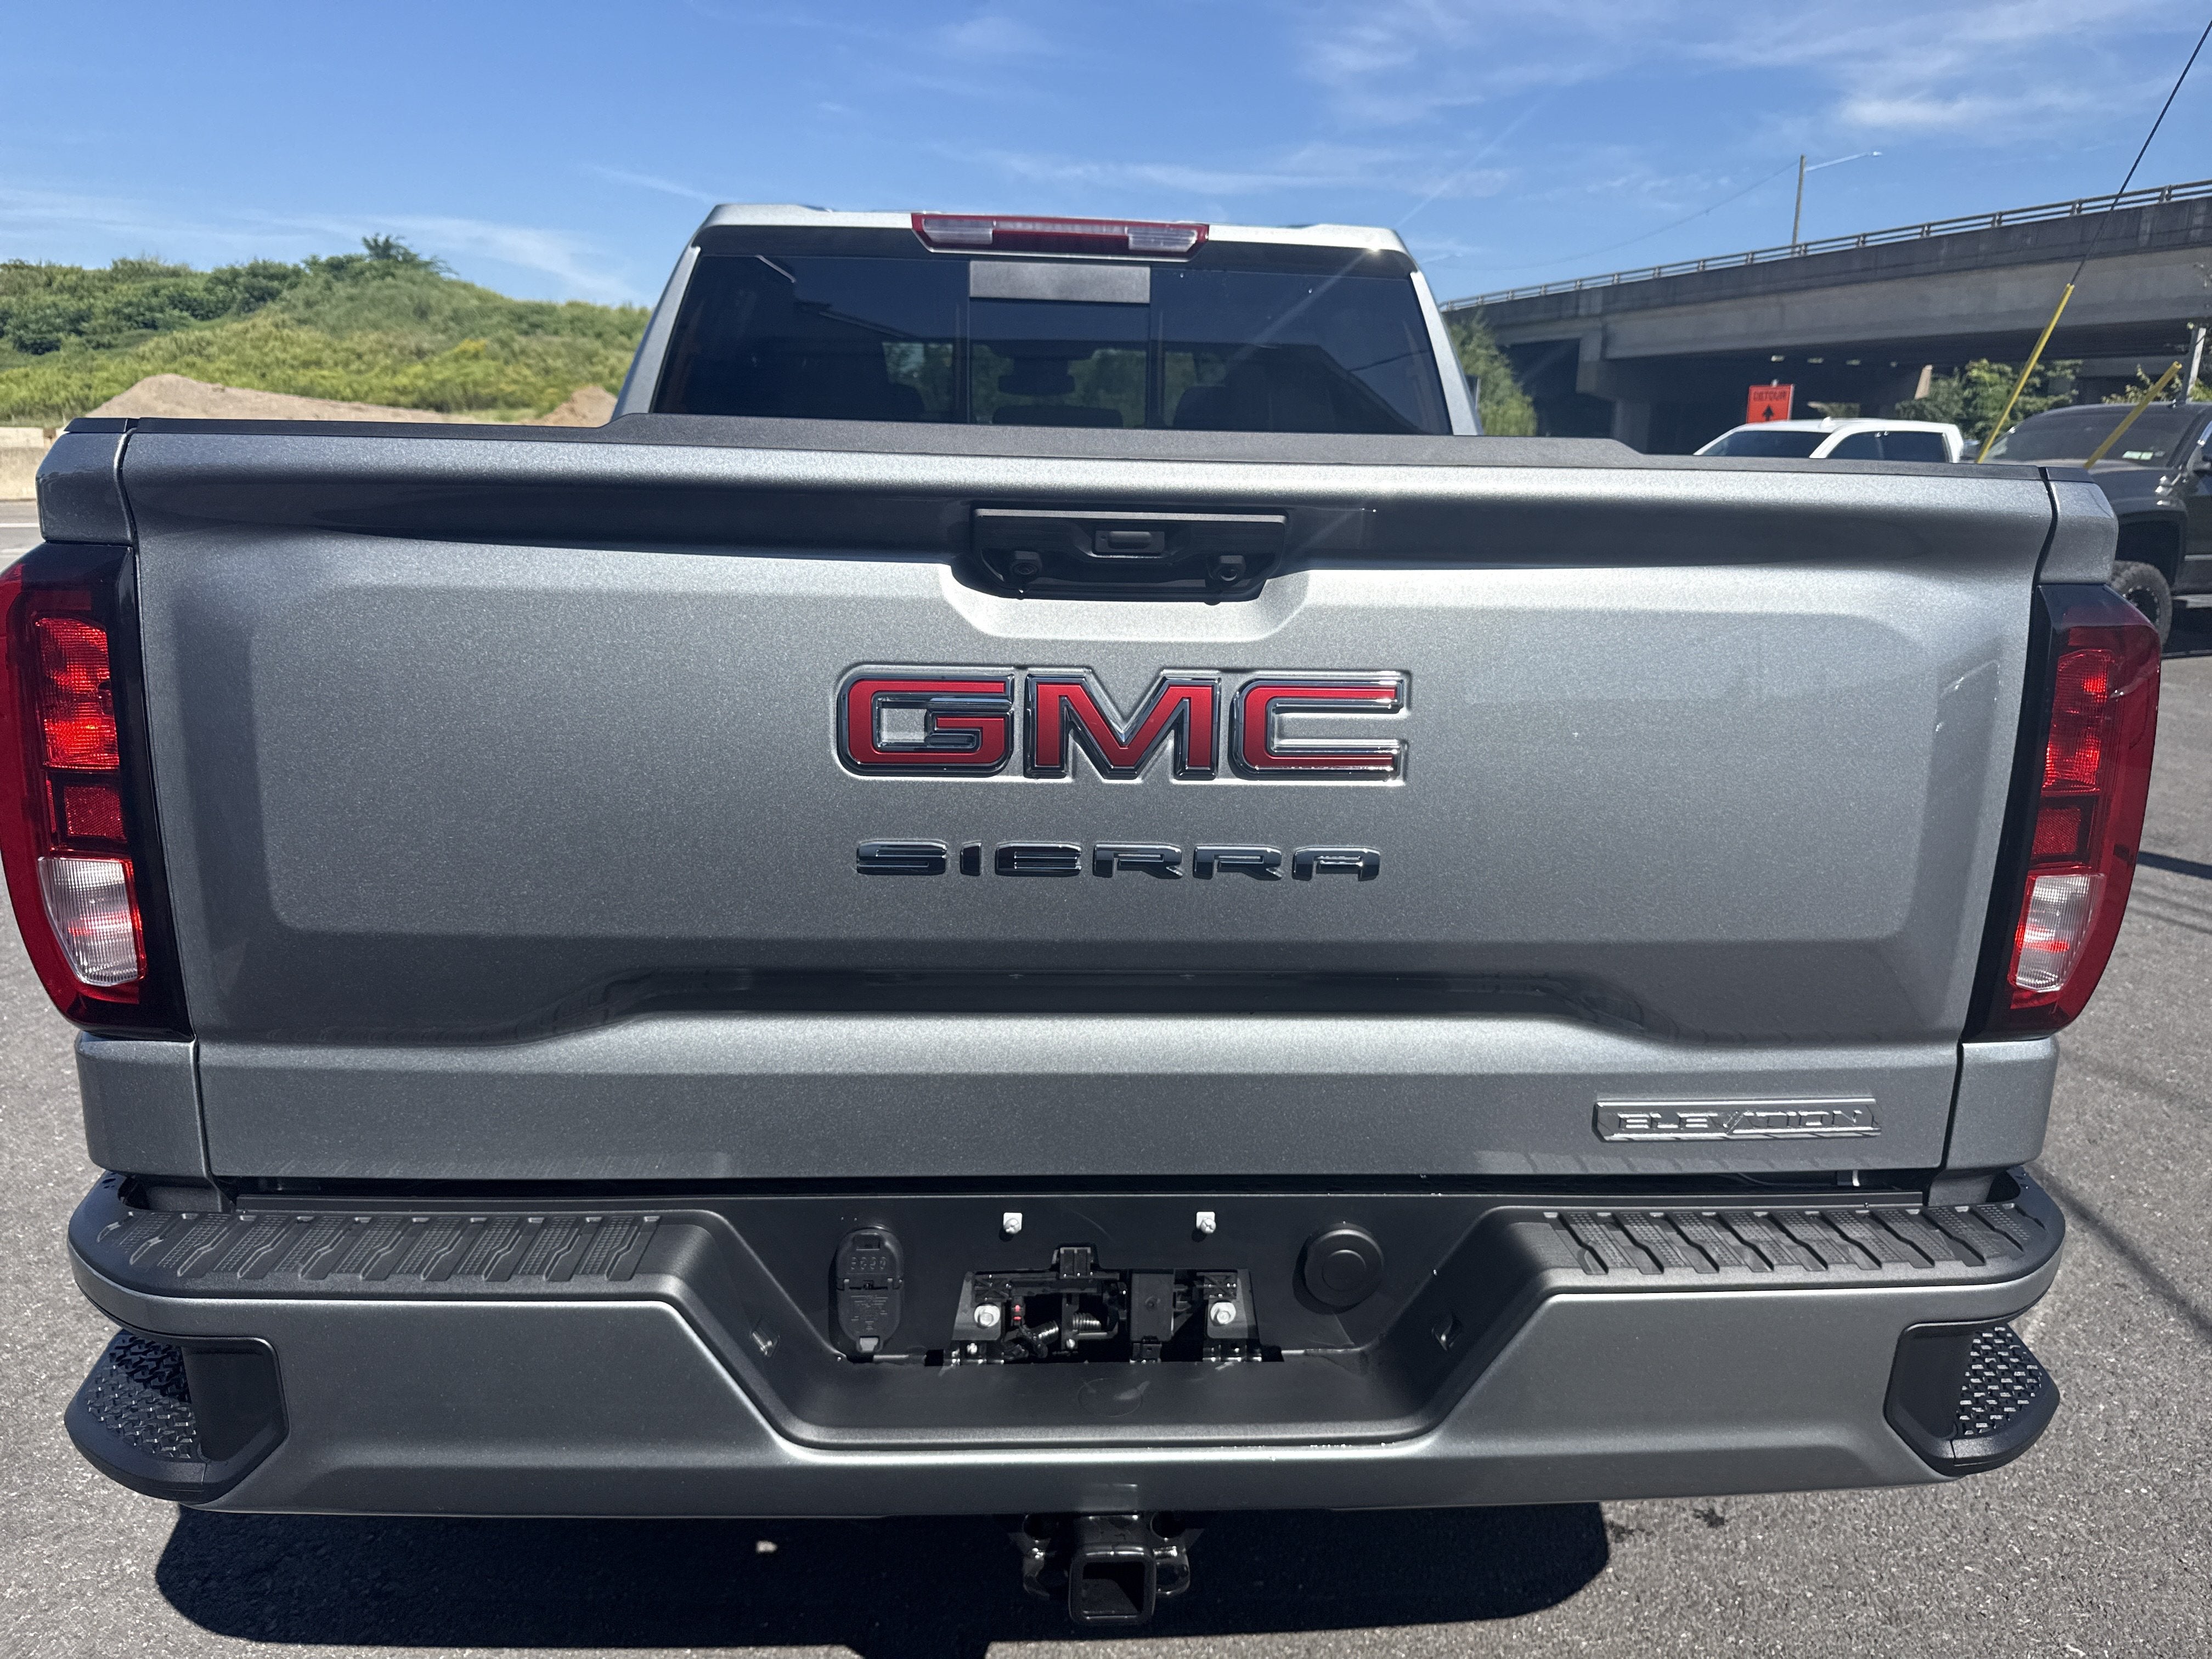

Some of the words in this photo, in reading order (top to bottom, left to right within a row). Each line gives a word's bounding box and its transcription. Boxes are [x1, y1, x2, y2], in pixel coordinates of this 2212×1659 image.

[1753, 390, 1787, 401] DETOUR
[837, 674, 1404, 781] GMC
[856, 839, 1381, 881] SIERRA
[1616, 1110, 1863, 1130] ELEVATION
